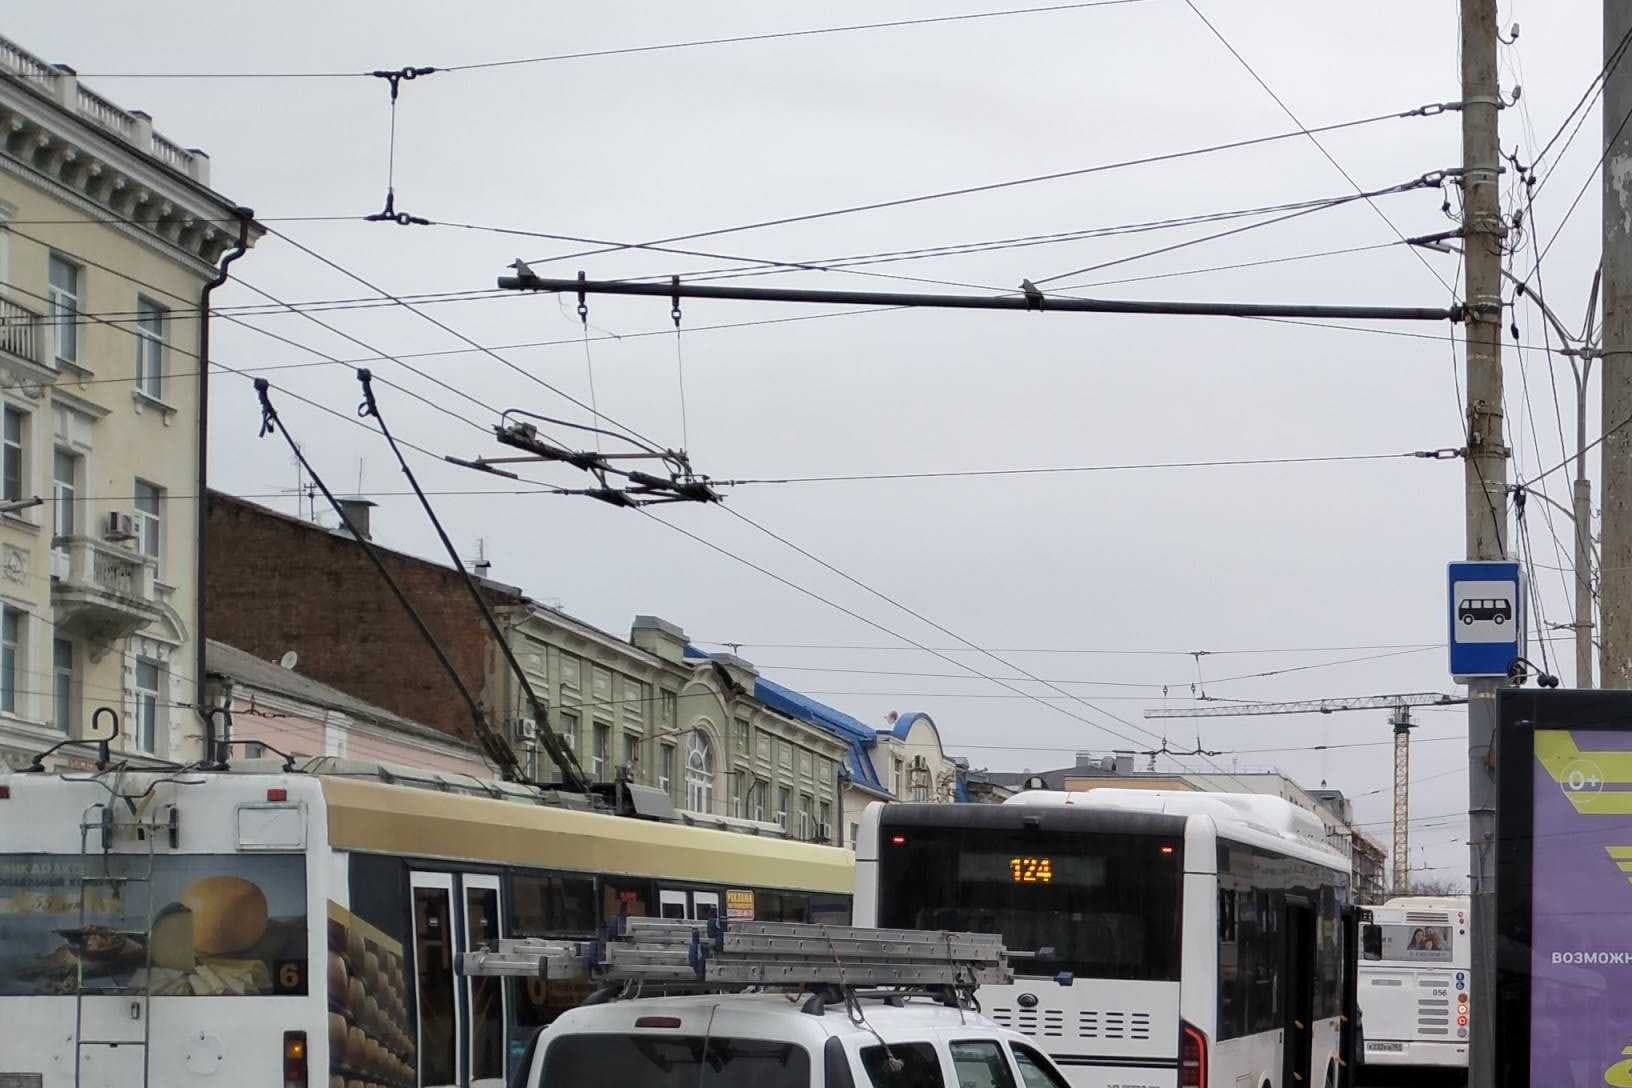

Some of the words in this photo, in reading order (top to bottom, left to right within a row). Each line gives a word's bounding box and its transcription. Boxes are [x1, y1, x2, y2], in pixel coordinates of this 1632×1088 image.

[1011, 859, 1052, 882] 124
[279, 963, 299, 988] 6
[1432, 988, 1447, 997] 056
